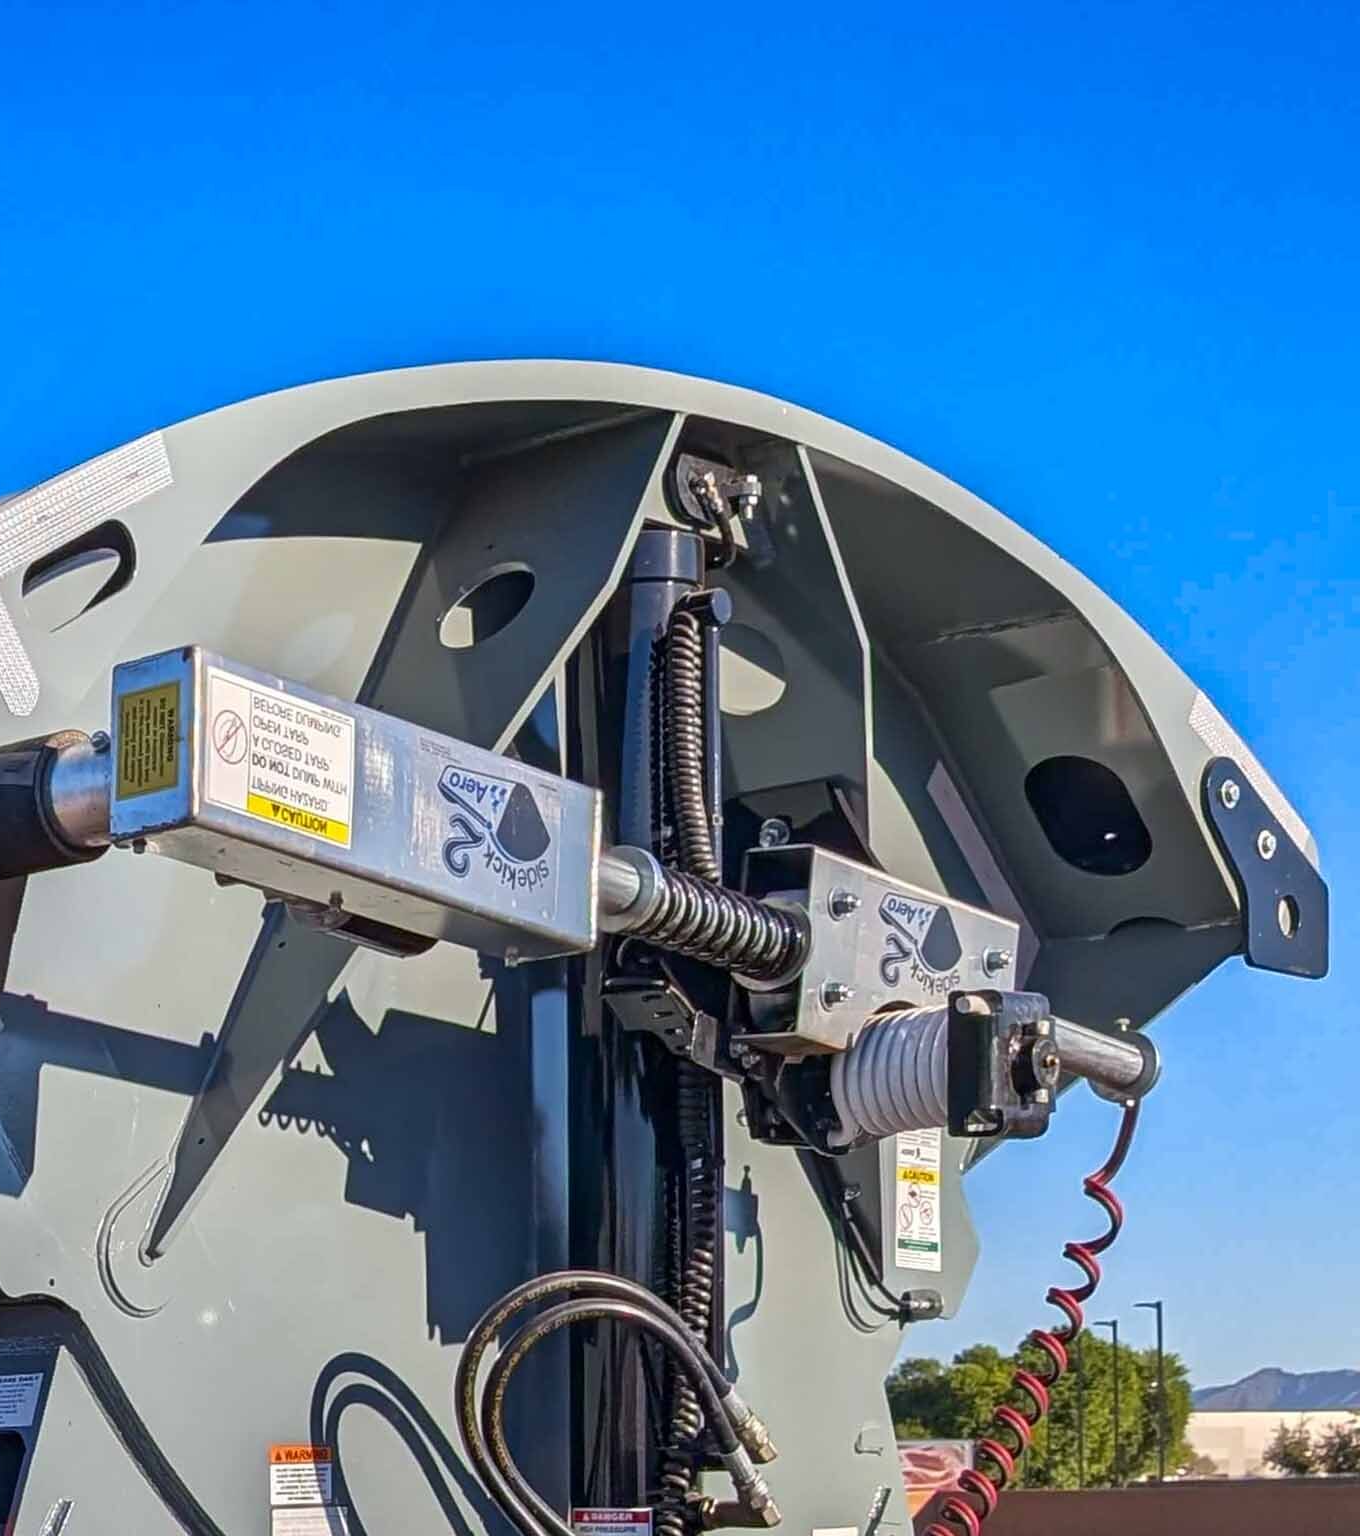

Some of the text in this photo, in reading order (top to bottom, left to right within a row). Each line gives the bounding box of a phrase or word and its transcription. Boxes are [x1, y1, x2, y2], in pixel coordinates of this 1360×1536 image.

[449, 772, 488, 804] Aero
[442, 813, 486, 878] 2
[483, 844, 550, 893] sidekick
[887, 898, 918, 925] Aero
[879, 933, 912, 988] 2
[910, 959, 960, 996] sidekick
[285, 1447, 329, 1461] WARNING
[591, 1512, 634, 1521] DANGER
